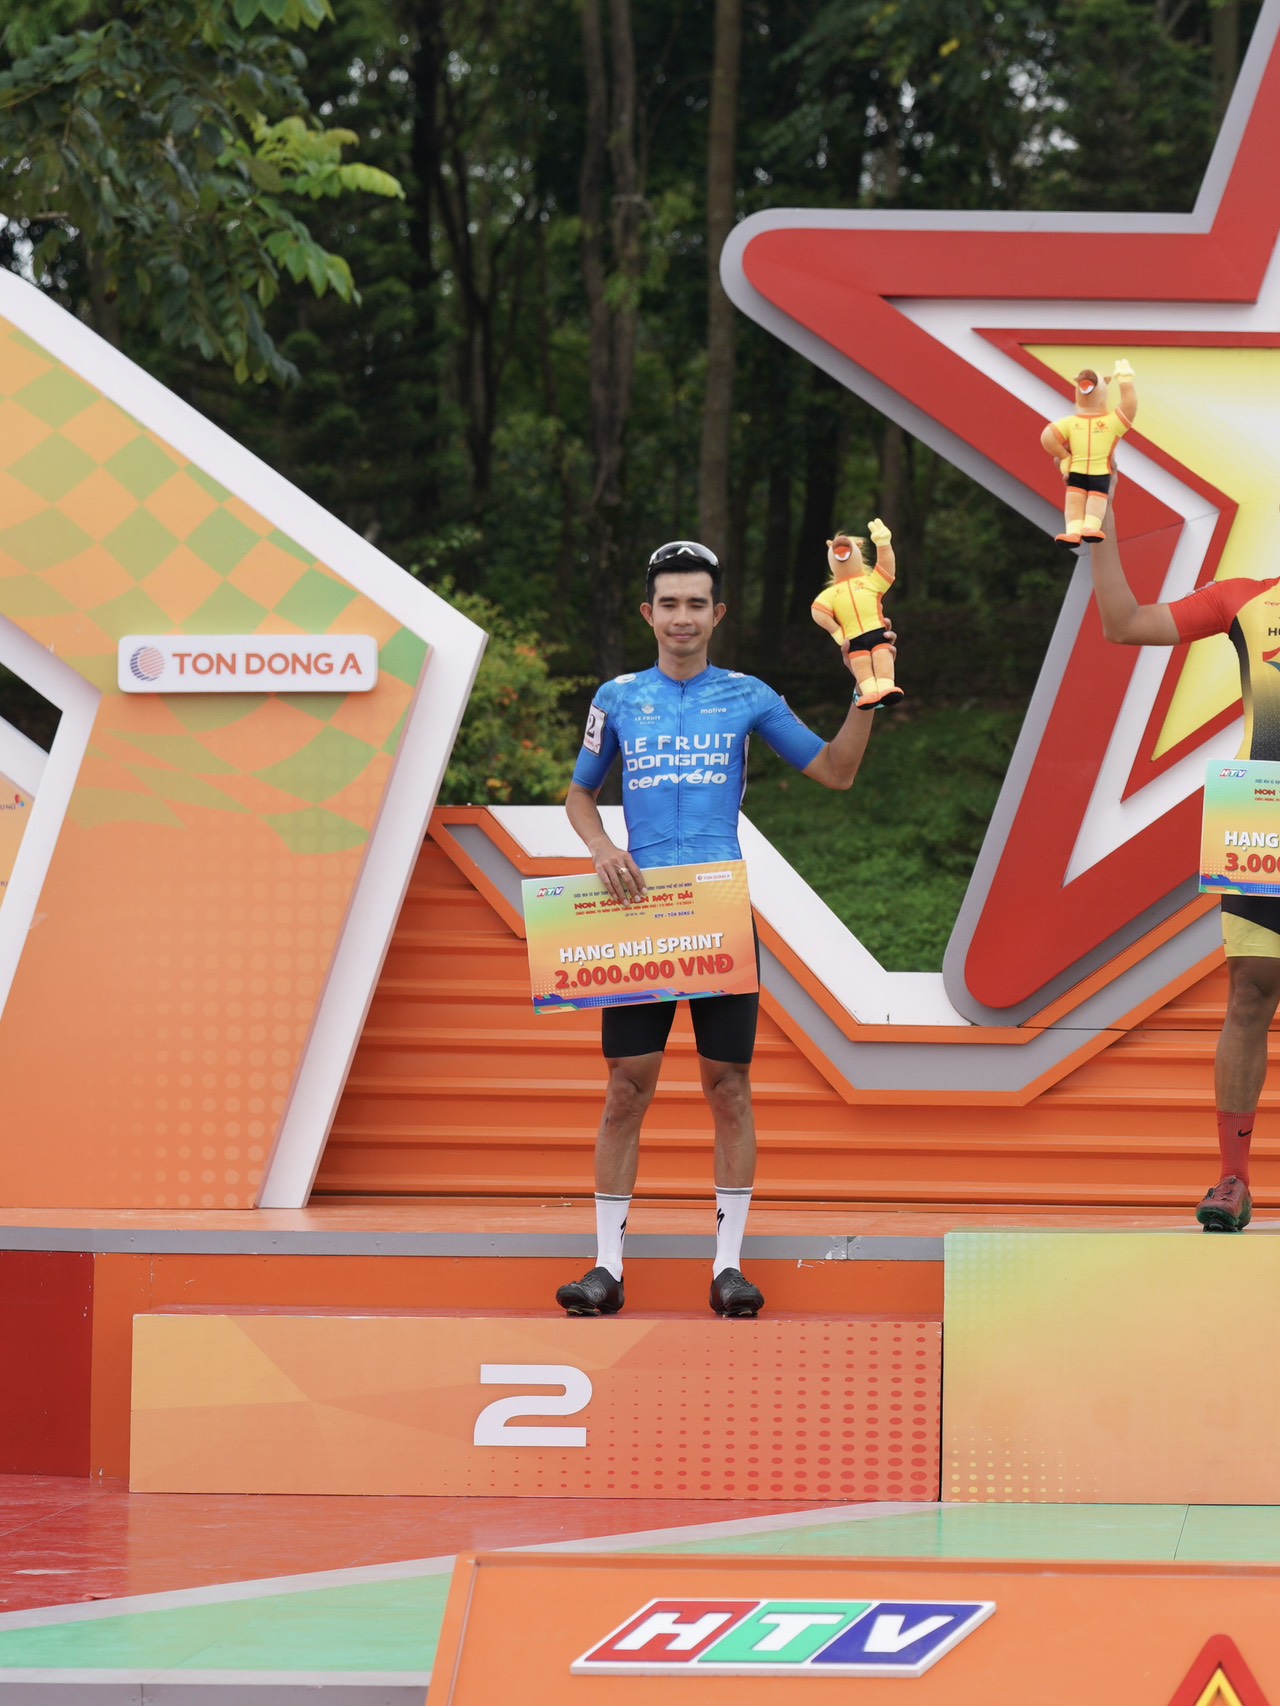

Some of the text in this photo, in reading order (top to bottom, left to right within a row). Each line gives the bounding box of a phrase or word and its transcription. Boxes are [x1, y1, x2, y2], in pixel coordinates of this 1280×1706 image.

[172, 653, 363, 675] TON DONG A
[624, 733, 736, 756] LE FRUIT
[628, 768, 728, 790] cervélo
[1220, 769, 1246, 778] HTV
[1254, 788, 1276, 796] NON
[1225, 830, 1279, 851] HẠNG
[537, 886, 564, 897] HTV
[574, 901, 597, 910] NON
[599, 898, 624, 907] SÔN
[559, 932, 724, 966] HẠNG NHÌ SPRINT
[554, 953, 734, 990] 2.000.000 VNĐ
[473, 1364, 593, 1447] 2
[611, 1610, 960, 1653] HTV
